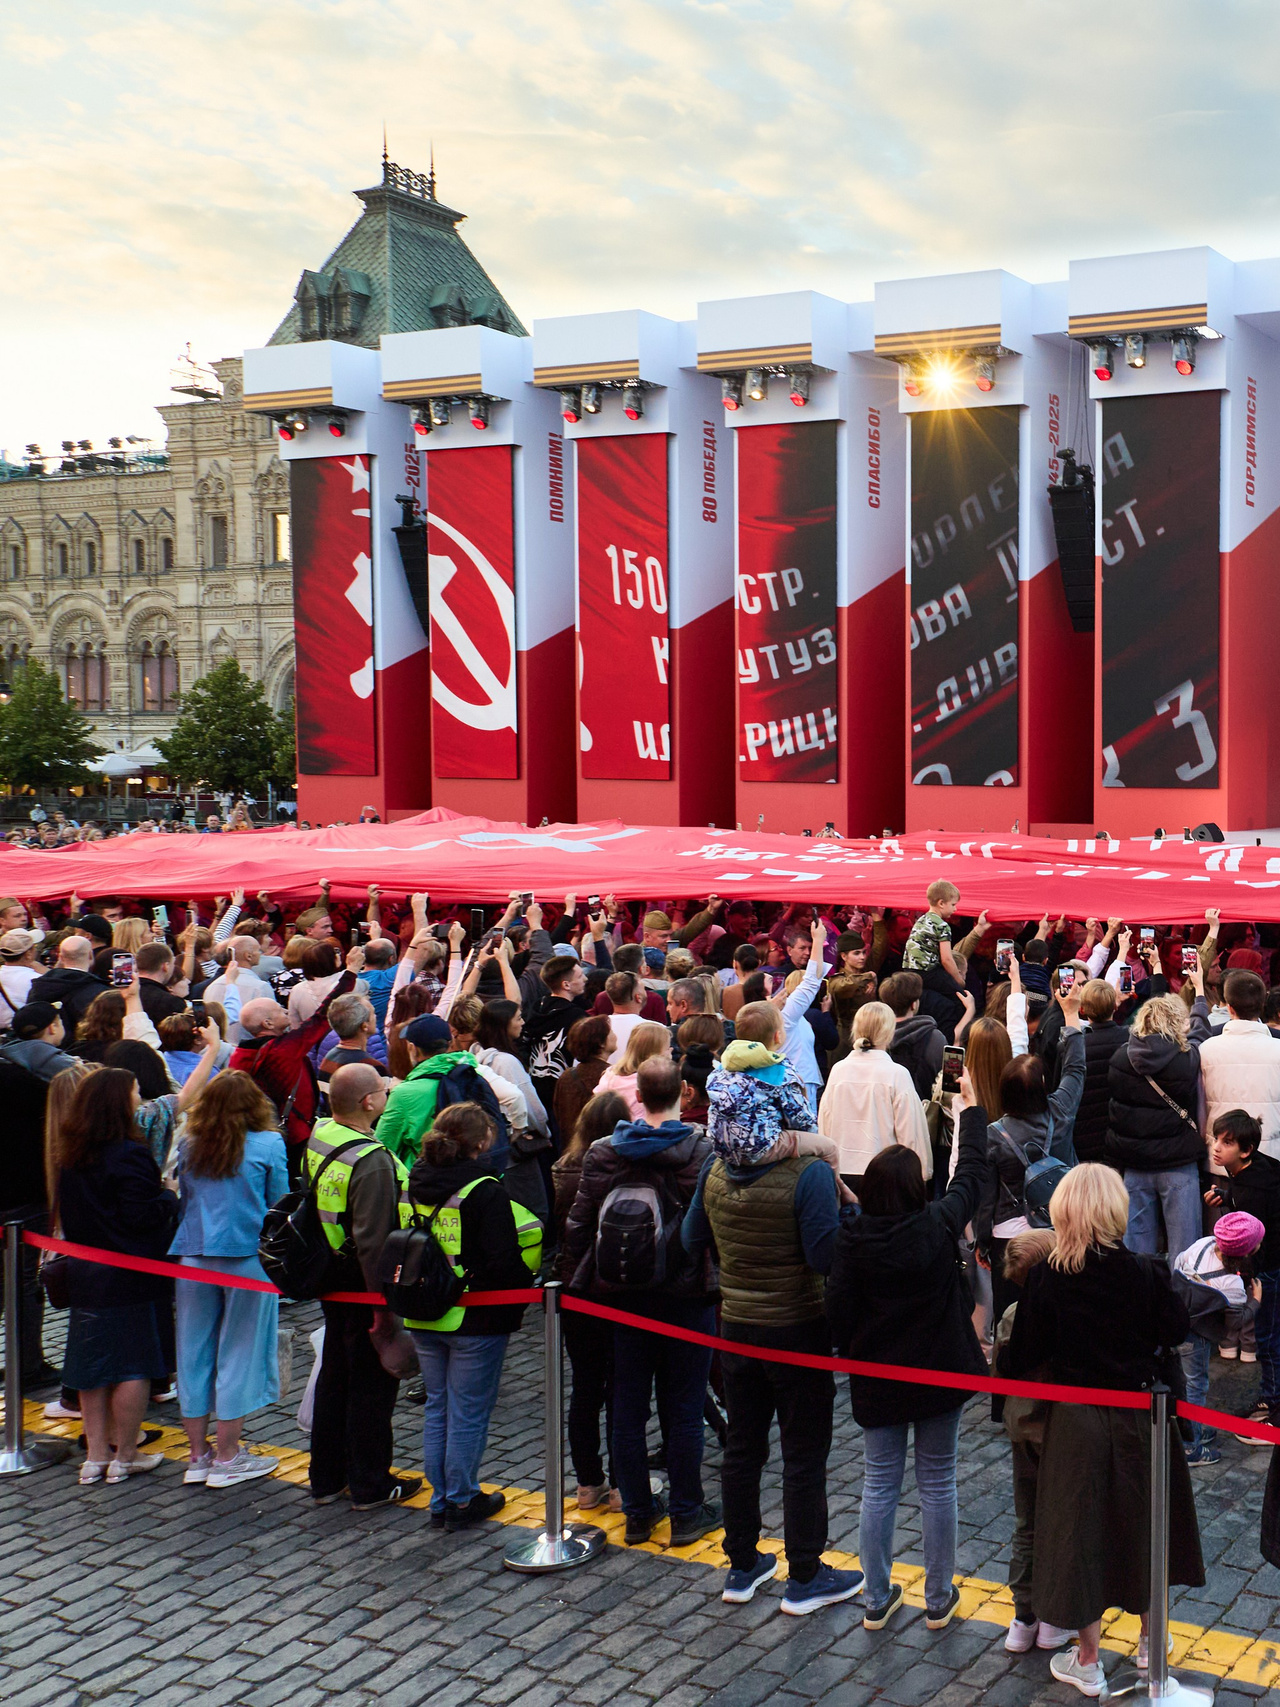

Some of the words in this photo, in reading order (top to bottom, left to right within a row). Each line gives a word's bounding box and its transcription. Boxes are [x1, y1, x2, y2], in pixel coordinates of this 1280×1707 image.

[548, 432, 564, 523] ПОМНИМ!
[703, 420, 718, 495] ПОБЕДА!
[867, 406, 881, 509] СПАСИБО!
[1245, 376, 1257, 508] ГОРДИМСЯ!
[702, 496, 718, 523] 80
[604, 543, 668, 615] 150
[739, 567, 820, 615] СТР.
